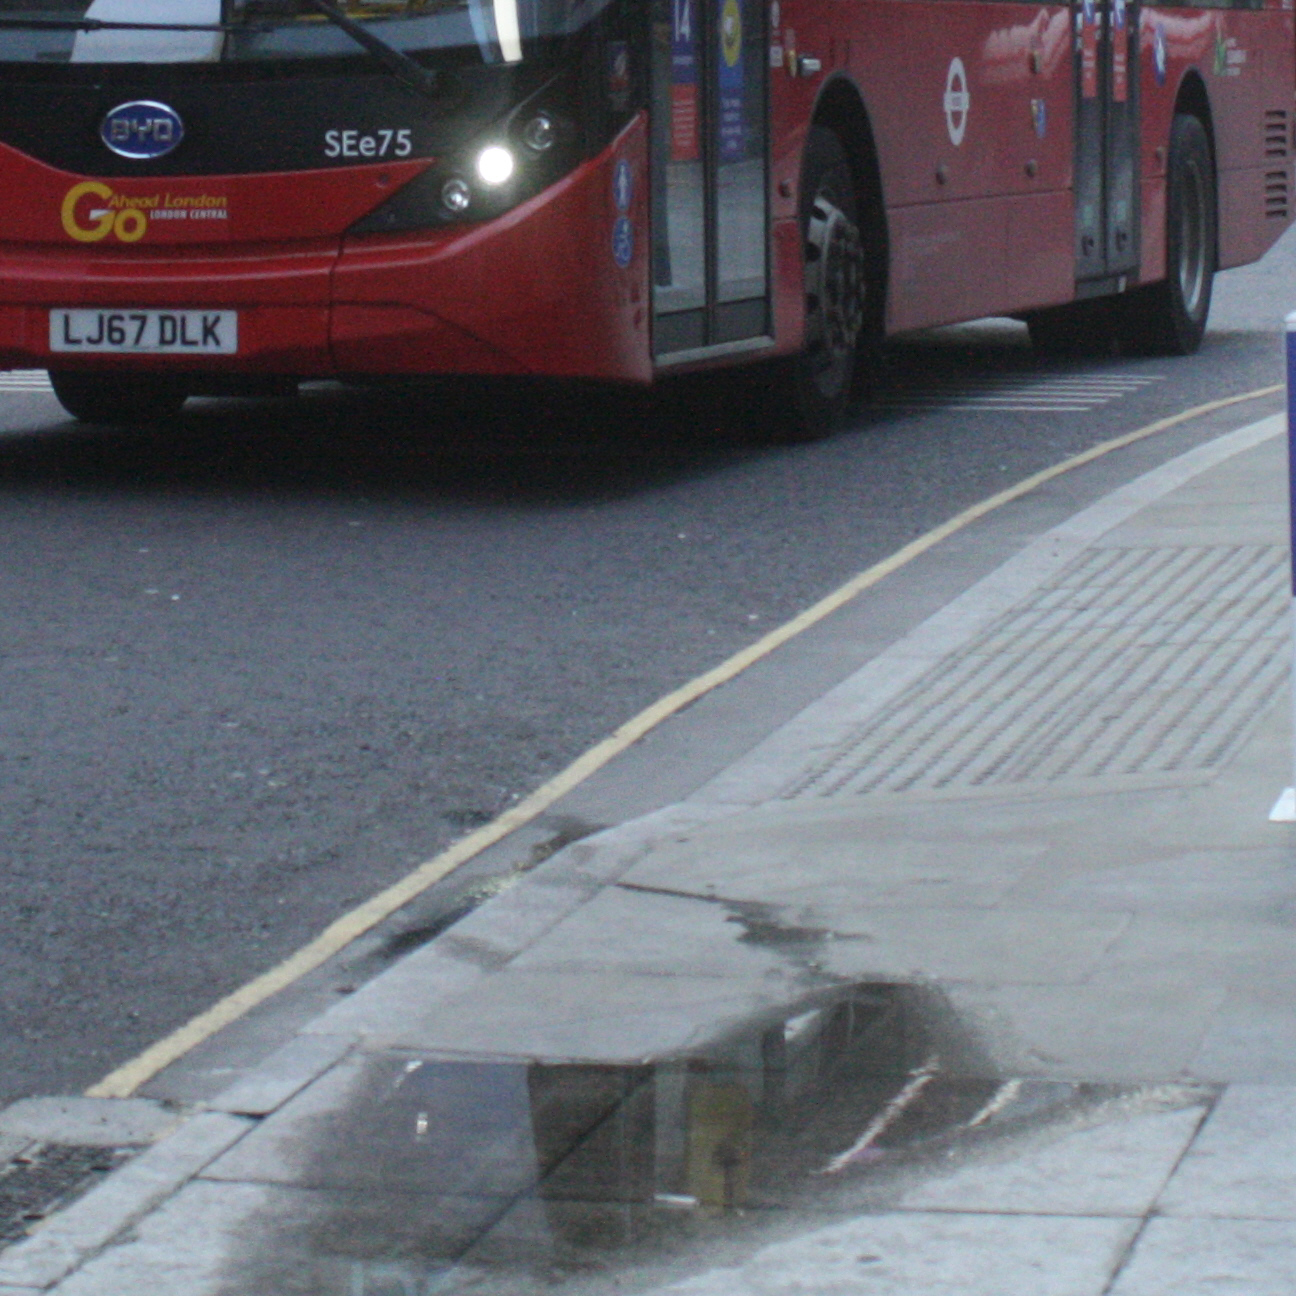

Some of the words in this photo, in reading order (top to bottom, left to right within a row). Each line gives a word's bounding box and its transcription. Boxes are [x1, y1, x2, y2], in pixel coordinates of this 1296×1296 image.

[110, 117, 174, 143] BYD
[324, 129, 412, 157] SEe75
[61, 181, 147, 243] Go
[108, 194, 160, 208] Ahead
[164, 193, 227, 207] London
[150, 209, 187, 219] LONDON
[190, 209, 228, 219] CENTRAL
[63, 313, 148, 345] LJ67
[158, 314, 221, 346] DLK
